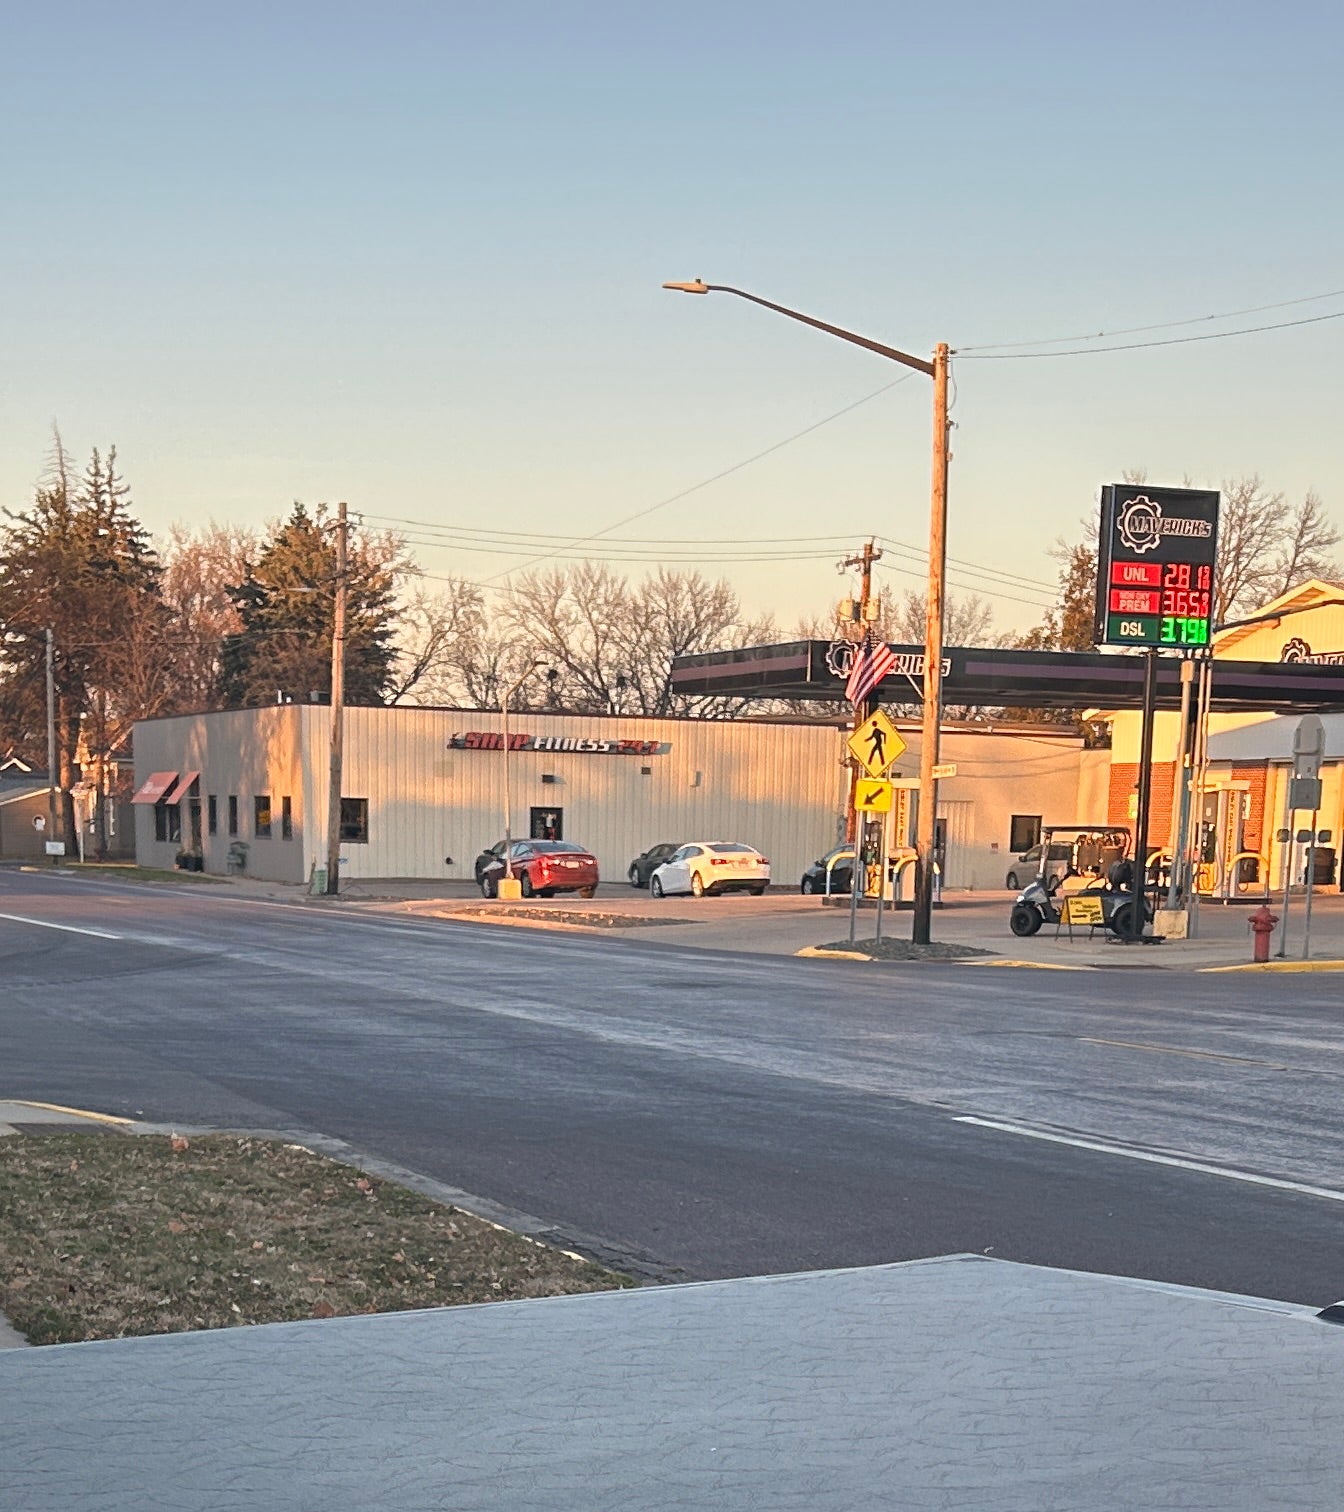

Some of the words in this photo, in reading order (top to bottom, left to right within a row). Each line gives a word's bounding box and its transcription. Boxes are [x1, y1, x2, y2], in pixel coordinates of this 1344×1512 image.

[1123, 567, 1149, 582] UNL
[1119, 599, 1150, 613] PREM
[1119, 621, 1145, 637] DSL
[533, 736, 610, 752] FITNESS
